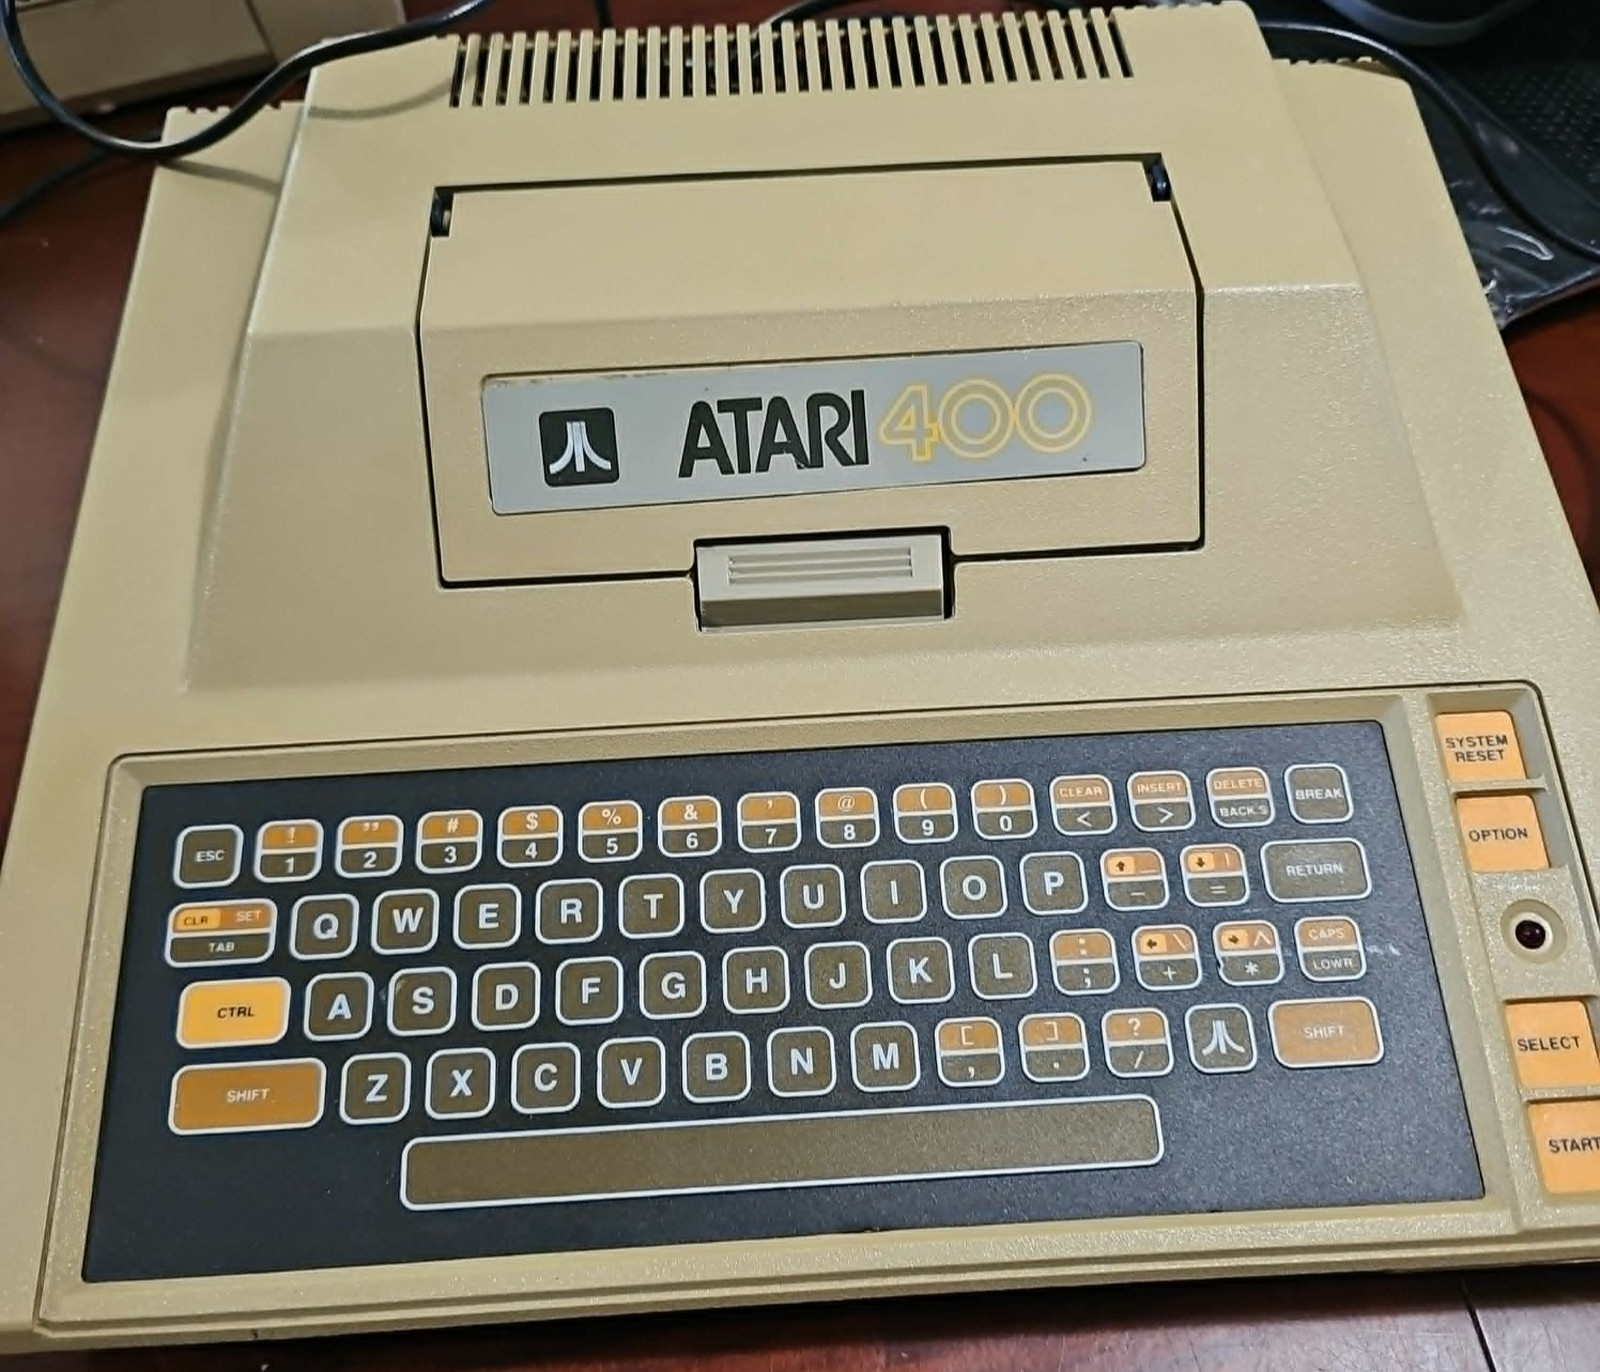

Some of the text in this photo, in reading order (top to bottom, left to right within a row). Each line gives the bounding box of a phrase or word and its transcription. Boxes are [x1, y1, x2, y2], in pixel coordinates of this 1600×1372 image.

[678, 373, 1092, 479] ATARI 400
[1445, 735, 1508, 749] SYSTEM
[1455, 749, 1505, 763] RESET
[1058, 784, 1103, 798] CLEAR
[1136, 780, 1183, 794] INSERT
[1213, 776, 1263, 791] DELETE
[836, 794, 856, 812] @
[1296, 786, 1344, 802] BREAK
[526, 812, 538, 830] $
[602, 808, 621, 826] %
[682, 804, 699, 820] &
[446, 818, 460, 834] #
[844, 824, 856, 840] 8
[922, 819, 934, 836] 9
[1000, 814, 1012, 832] 0
[686, 832, 698, 849] 6
[765, 828, 777, 844] 7
[1469, 827, 1528, 842] OPTION
[196, 848, 225, 862] ESC
[444, 846, 458, 863] 3
[525, 842, 538, 860] 4
[606, 838, 618, 854] 5
[285, 857, 295, 874] 1
[363, 851, 377, 868] 2
[1286, 862, 1344, 878] RETURN
[889, 881, 898, 904] I
[962, 875, 986, 900] O
[1044, 872, 1065, 895] P
[723, 890, 745, 914] Y
[803, 884, 825, 909] U
[561, 899, 582, 923] R
[643, 894, 664, 918] T
[184, 915, 208, 928] CLR
[236, 910, 262, 923] SET
[393, 909, 424, 933] W
[479, 904, 498, 928] E
[314, 914, 338, 940] Q
[1308, 926, 1345, 940] CAPS
[208, 941, 234, 953] TAB
[910, 958, 932, 983] K
[994, 954, 1013, 978] L
[1312, 956, 1354, 972] LOWR
[746, 968, 768, 993] H
[828, 964, 846, 989] J
[582, 978, 602, 1003] F
[660, 973, 686, 999] G
[412, 988, 434, 1014] S
[496, 985, 518, 1010] D
[216, 1005, 255, 1019] CTRL
[328, 994, 352, 1020] A
[1128, 1018, 1142, 1036] ?
[1304, 1024, 1344, 1040] SHIFT
[1517, 1035, 1581, 1052] SELECT
[790, 1048, 814, 1074] N
[873, 1042, 899, 1069] M
[620, 1059, 643, 1086] V
[705, 1054, 728, 1080] B
[450, 1070, 473, 1097] X
[534, 1064, 558, 1092] C
[226, 1088, 270, 1104] SHIFT
[366, 1075, 388, 1101] Z
